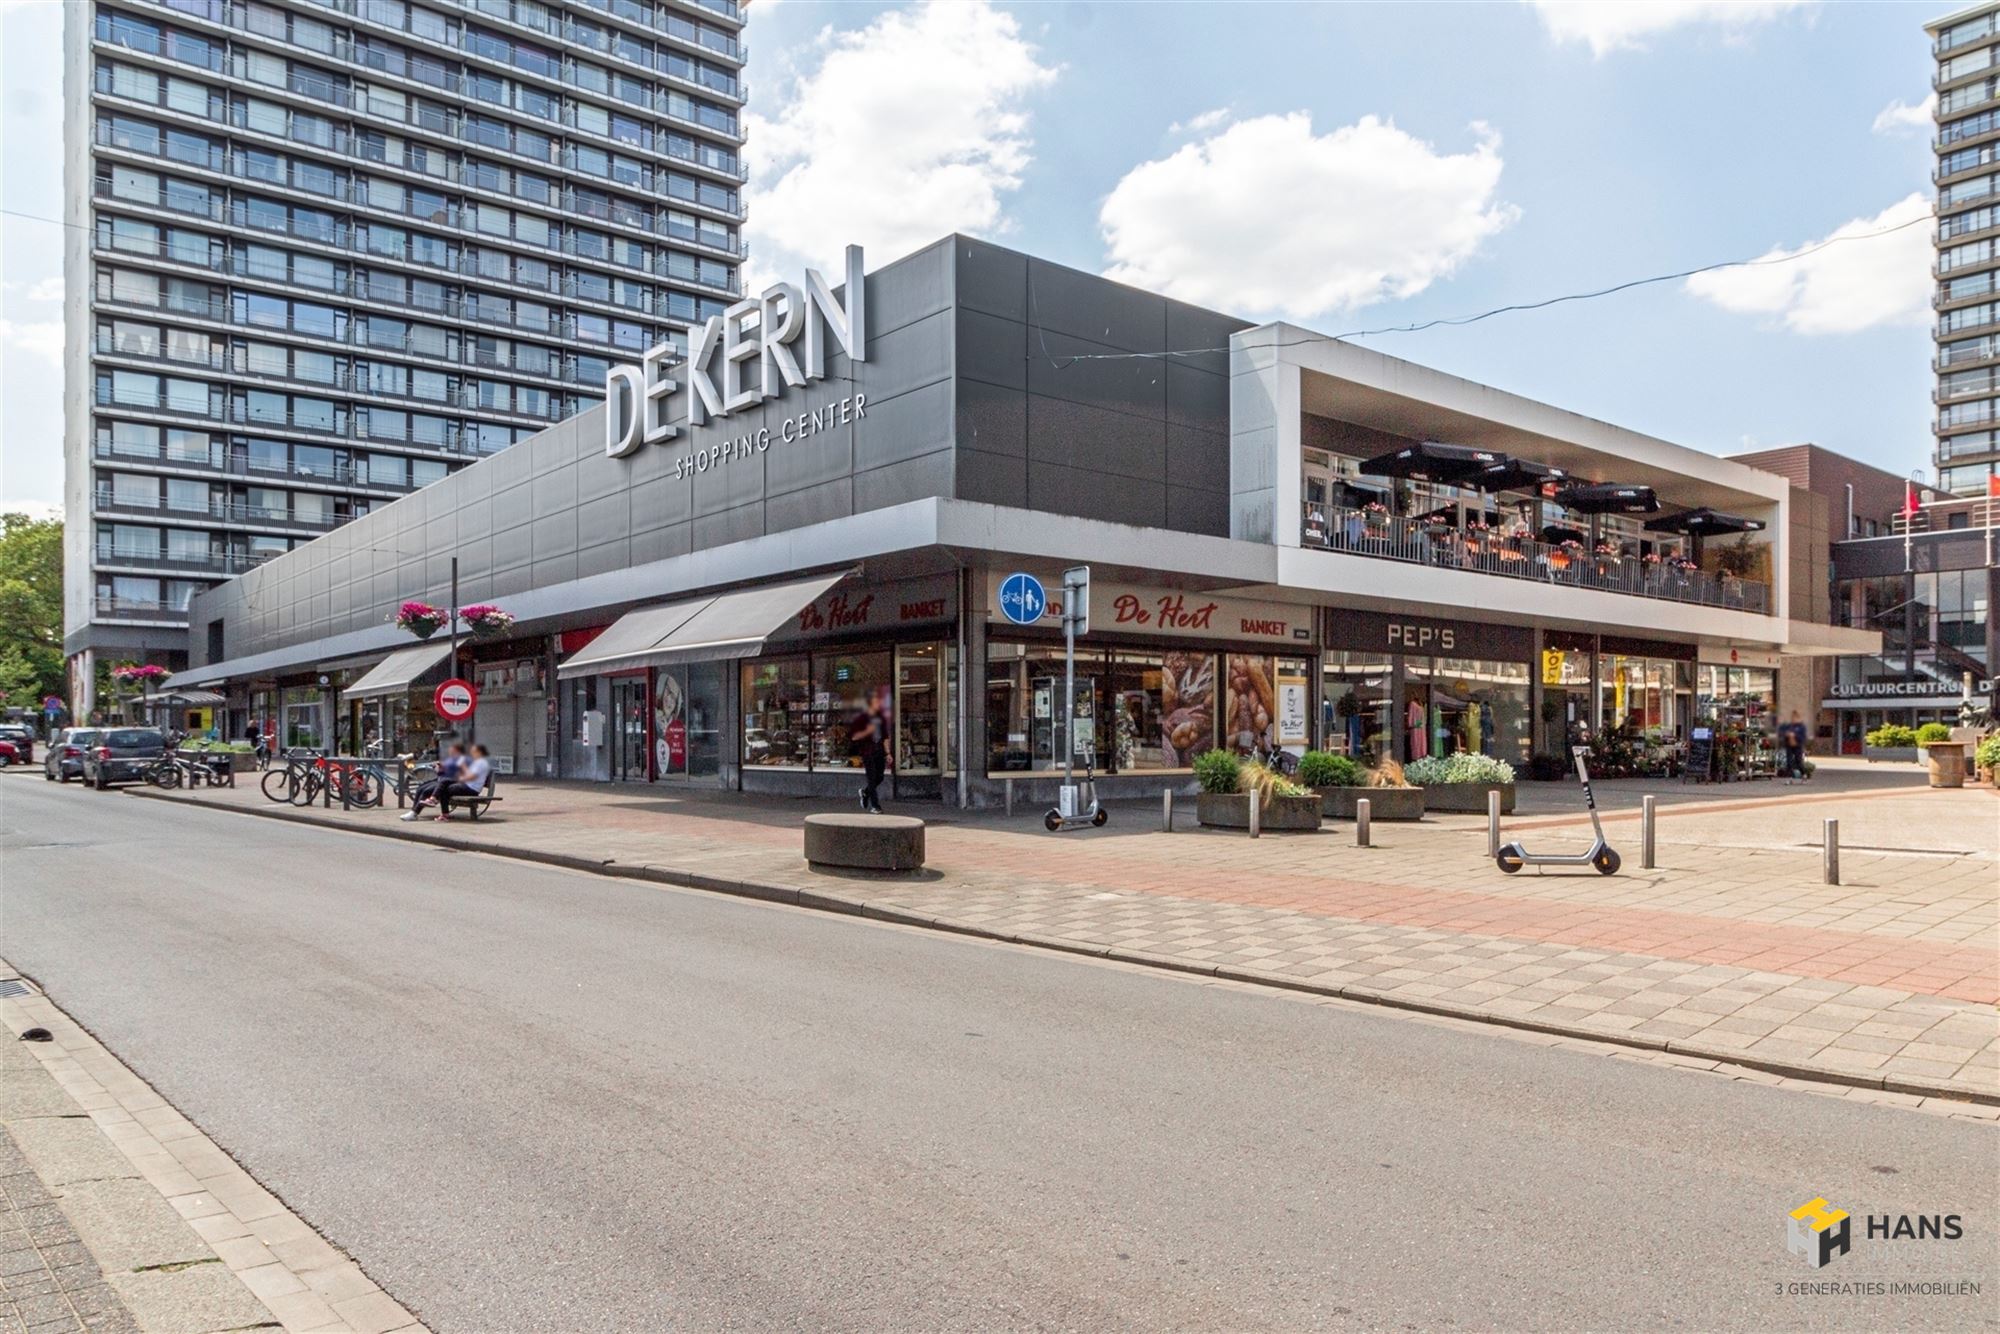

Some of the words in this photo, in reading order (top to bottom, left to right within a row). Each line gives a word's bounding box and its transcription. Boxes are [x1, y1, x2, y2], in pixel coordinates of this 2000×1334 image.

[606, 341, 678, 458] DE
[688, 243, 866, 426] KERN
[676, 428, 770, 480] SHOPPING
[782, 393, 867, 443] CENTER
[901, 599, 946, 620] BANKET
[1114, 594, 1150, 623] De
[1157, 595, 1218, 629] Hert
[1241, 618, 1287, 636] BANKET
[1388, 624, 1455, 649] PEP'S
